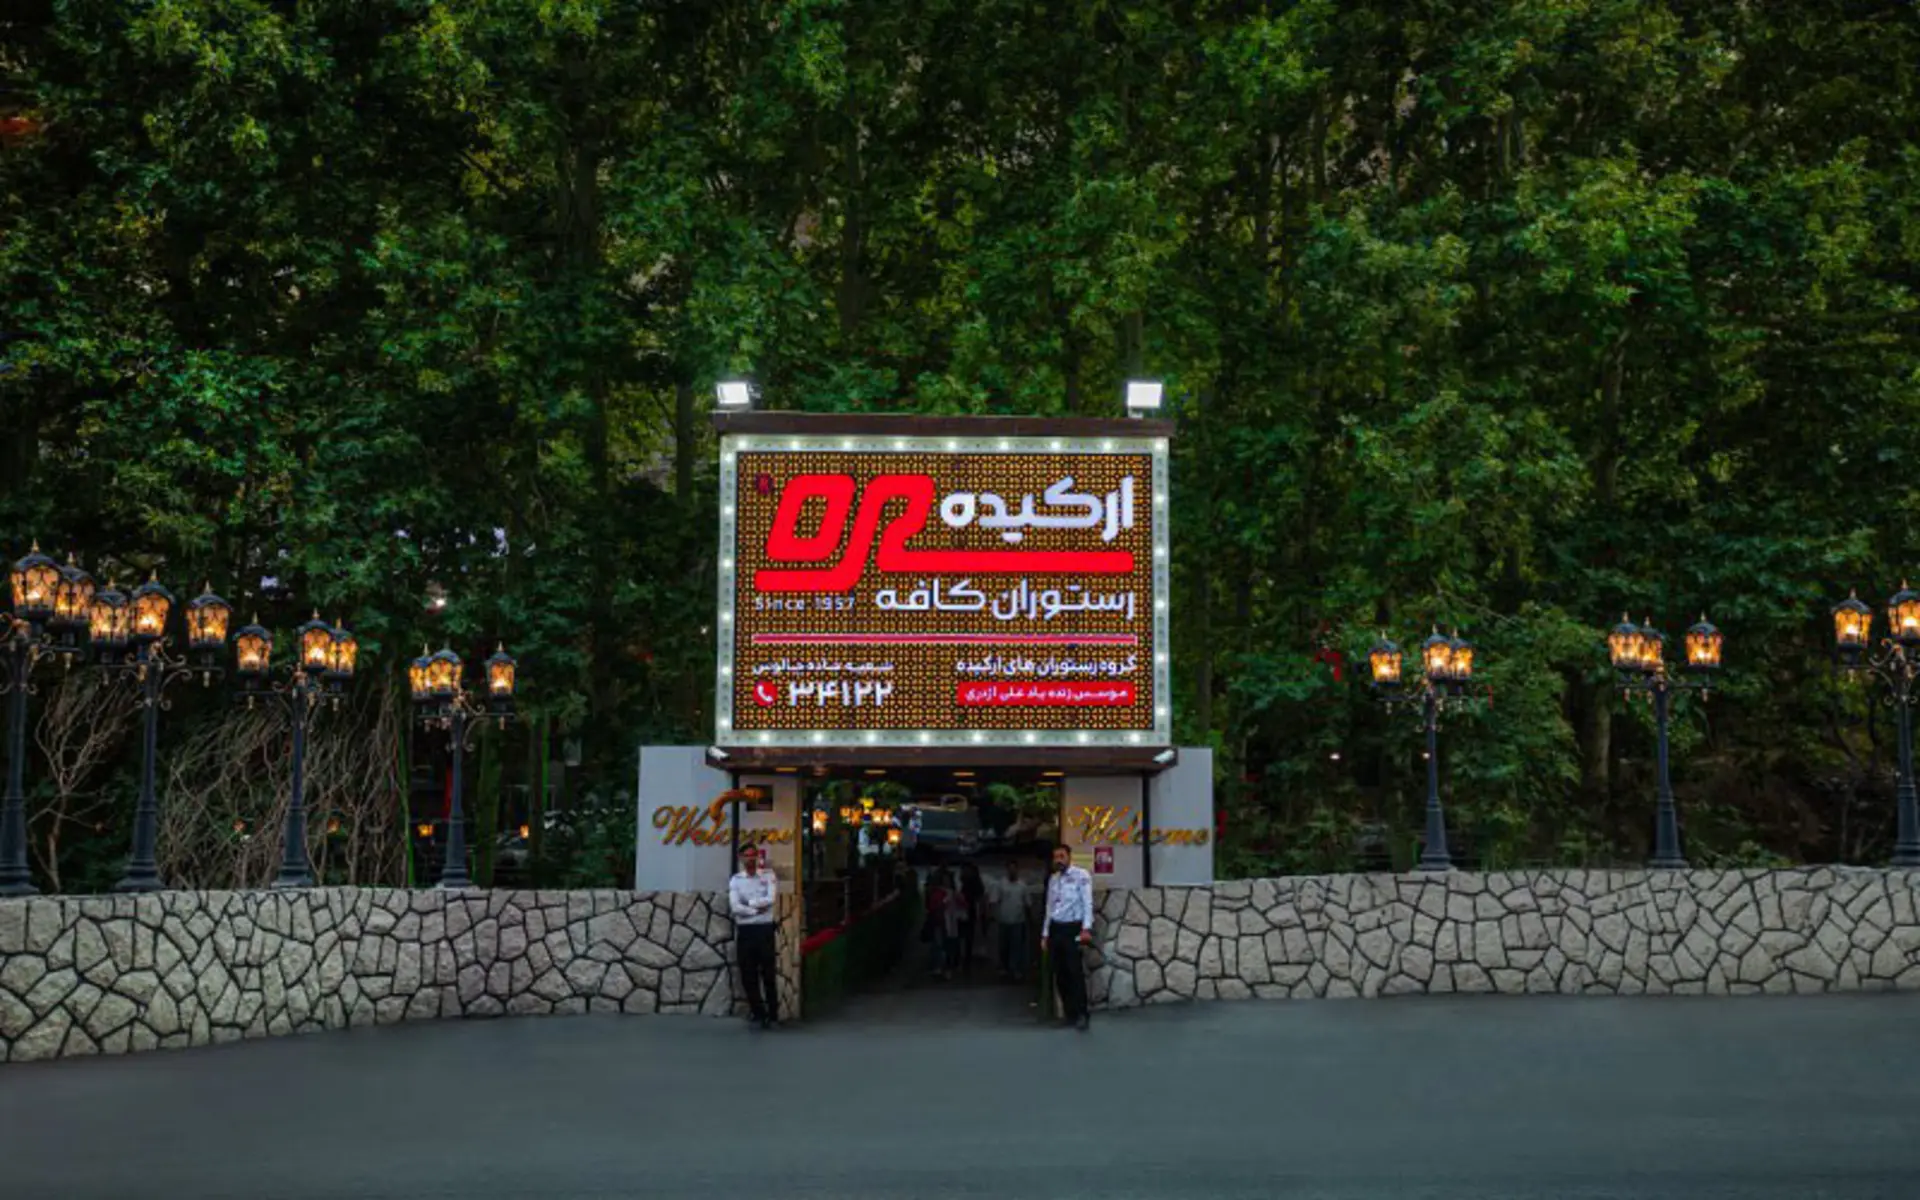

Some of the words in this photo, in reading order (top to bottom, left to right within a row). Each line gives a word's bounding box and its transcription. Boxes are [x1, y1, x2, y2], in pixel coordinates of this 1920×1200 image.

[940, 475, 1134, 542] ارکیده
[754, 596, 806, 611] Since
[876, 578, 987, 612] کافه
[992, 578, 1135, 621] رستوران
[956, 655, 1002, 676] ارکیده
[1003, 655, 1035, 676] های
[1036, 656, 1098, 676] رستوران
[1100, 653, 1138, 676] گروه
[789, 680, 894, 706] ۳۴۱۲۲
